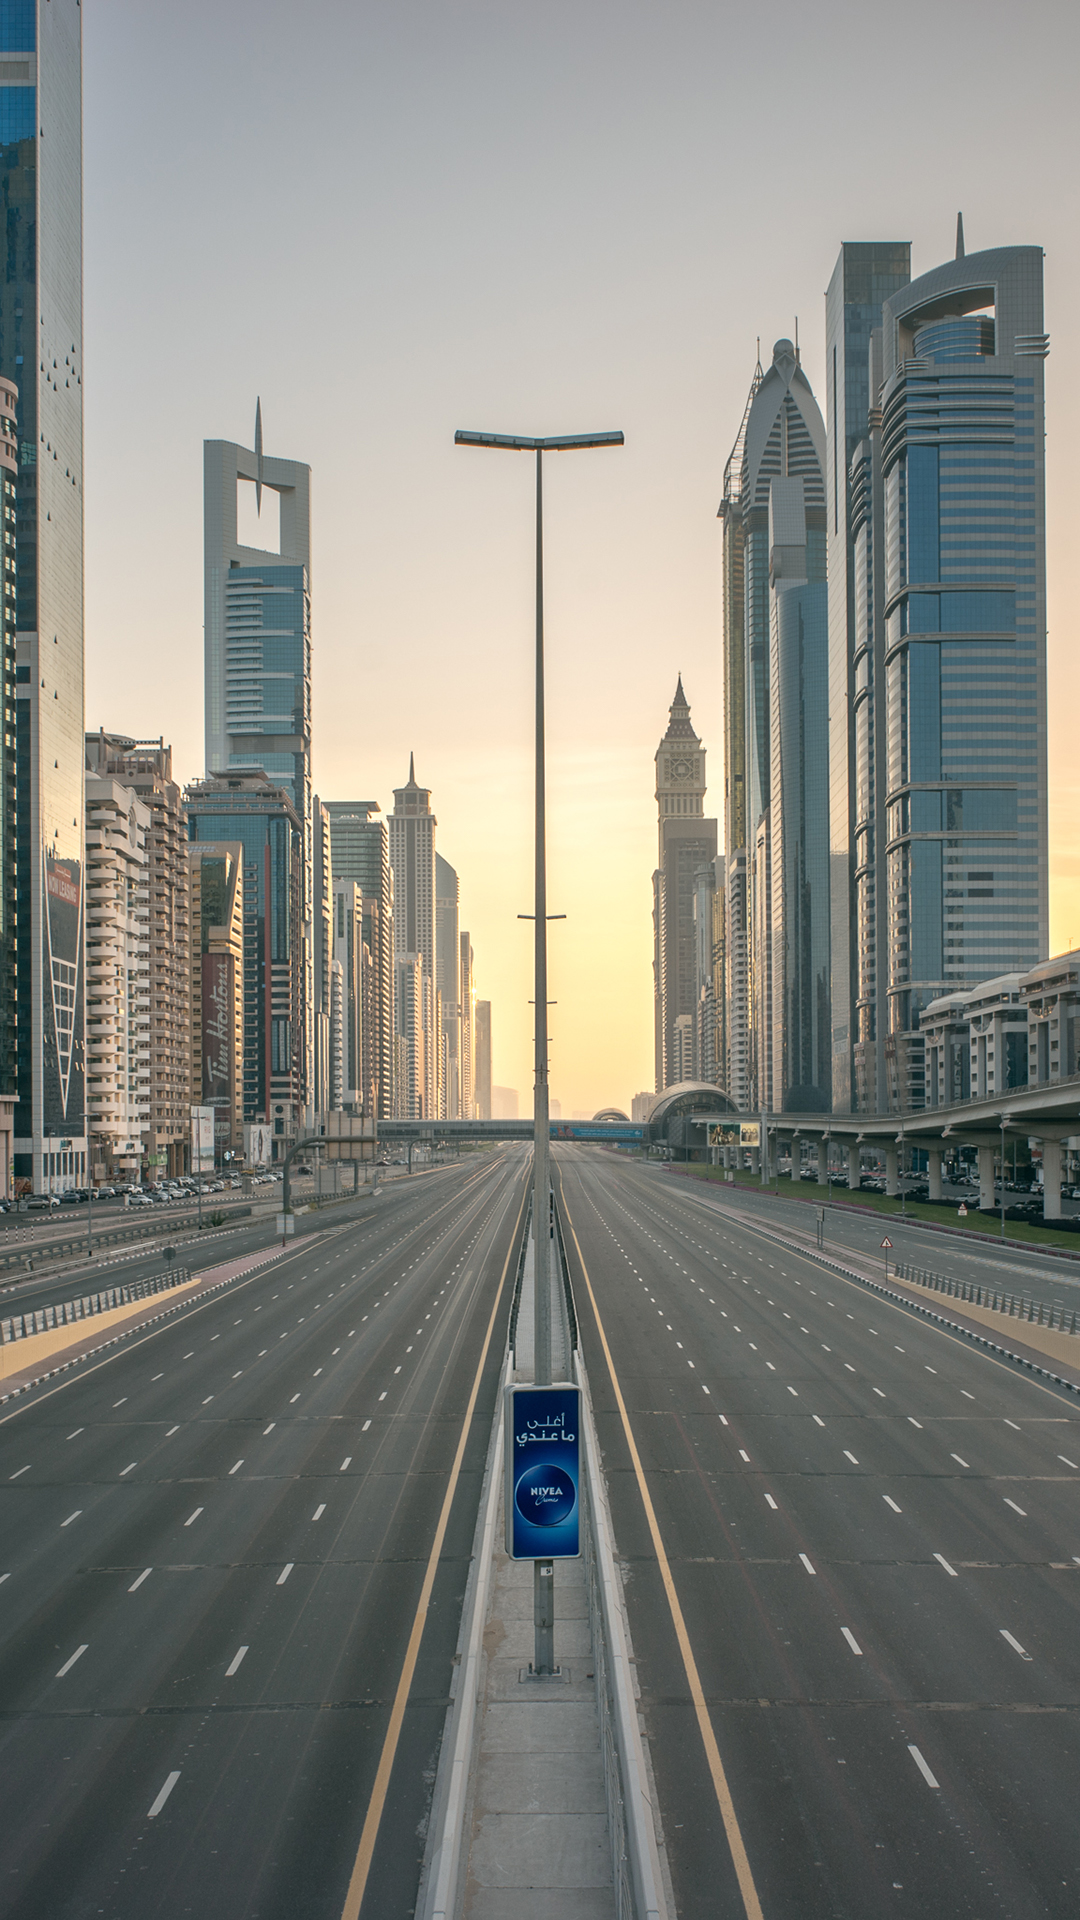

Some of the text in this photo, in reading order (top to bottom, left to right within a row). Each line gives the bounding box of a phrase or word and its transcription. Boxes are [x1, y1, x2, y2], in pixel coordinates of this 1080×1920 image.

[206, 963, 229, 1082] Tim Hortons
[527, 1412, 565, 1429] أغلى
[516, 1430, 575, 1446] ما عندي
[531, 1487, 563, 1495] NIVEA
